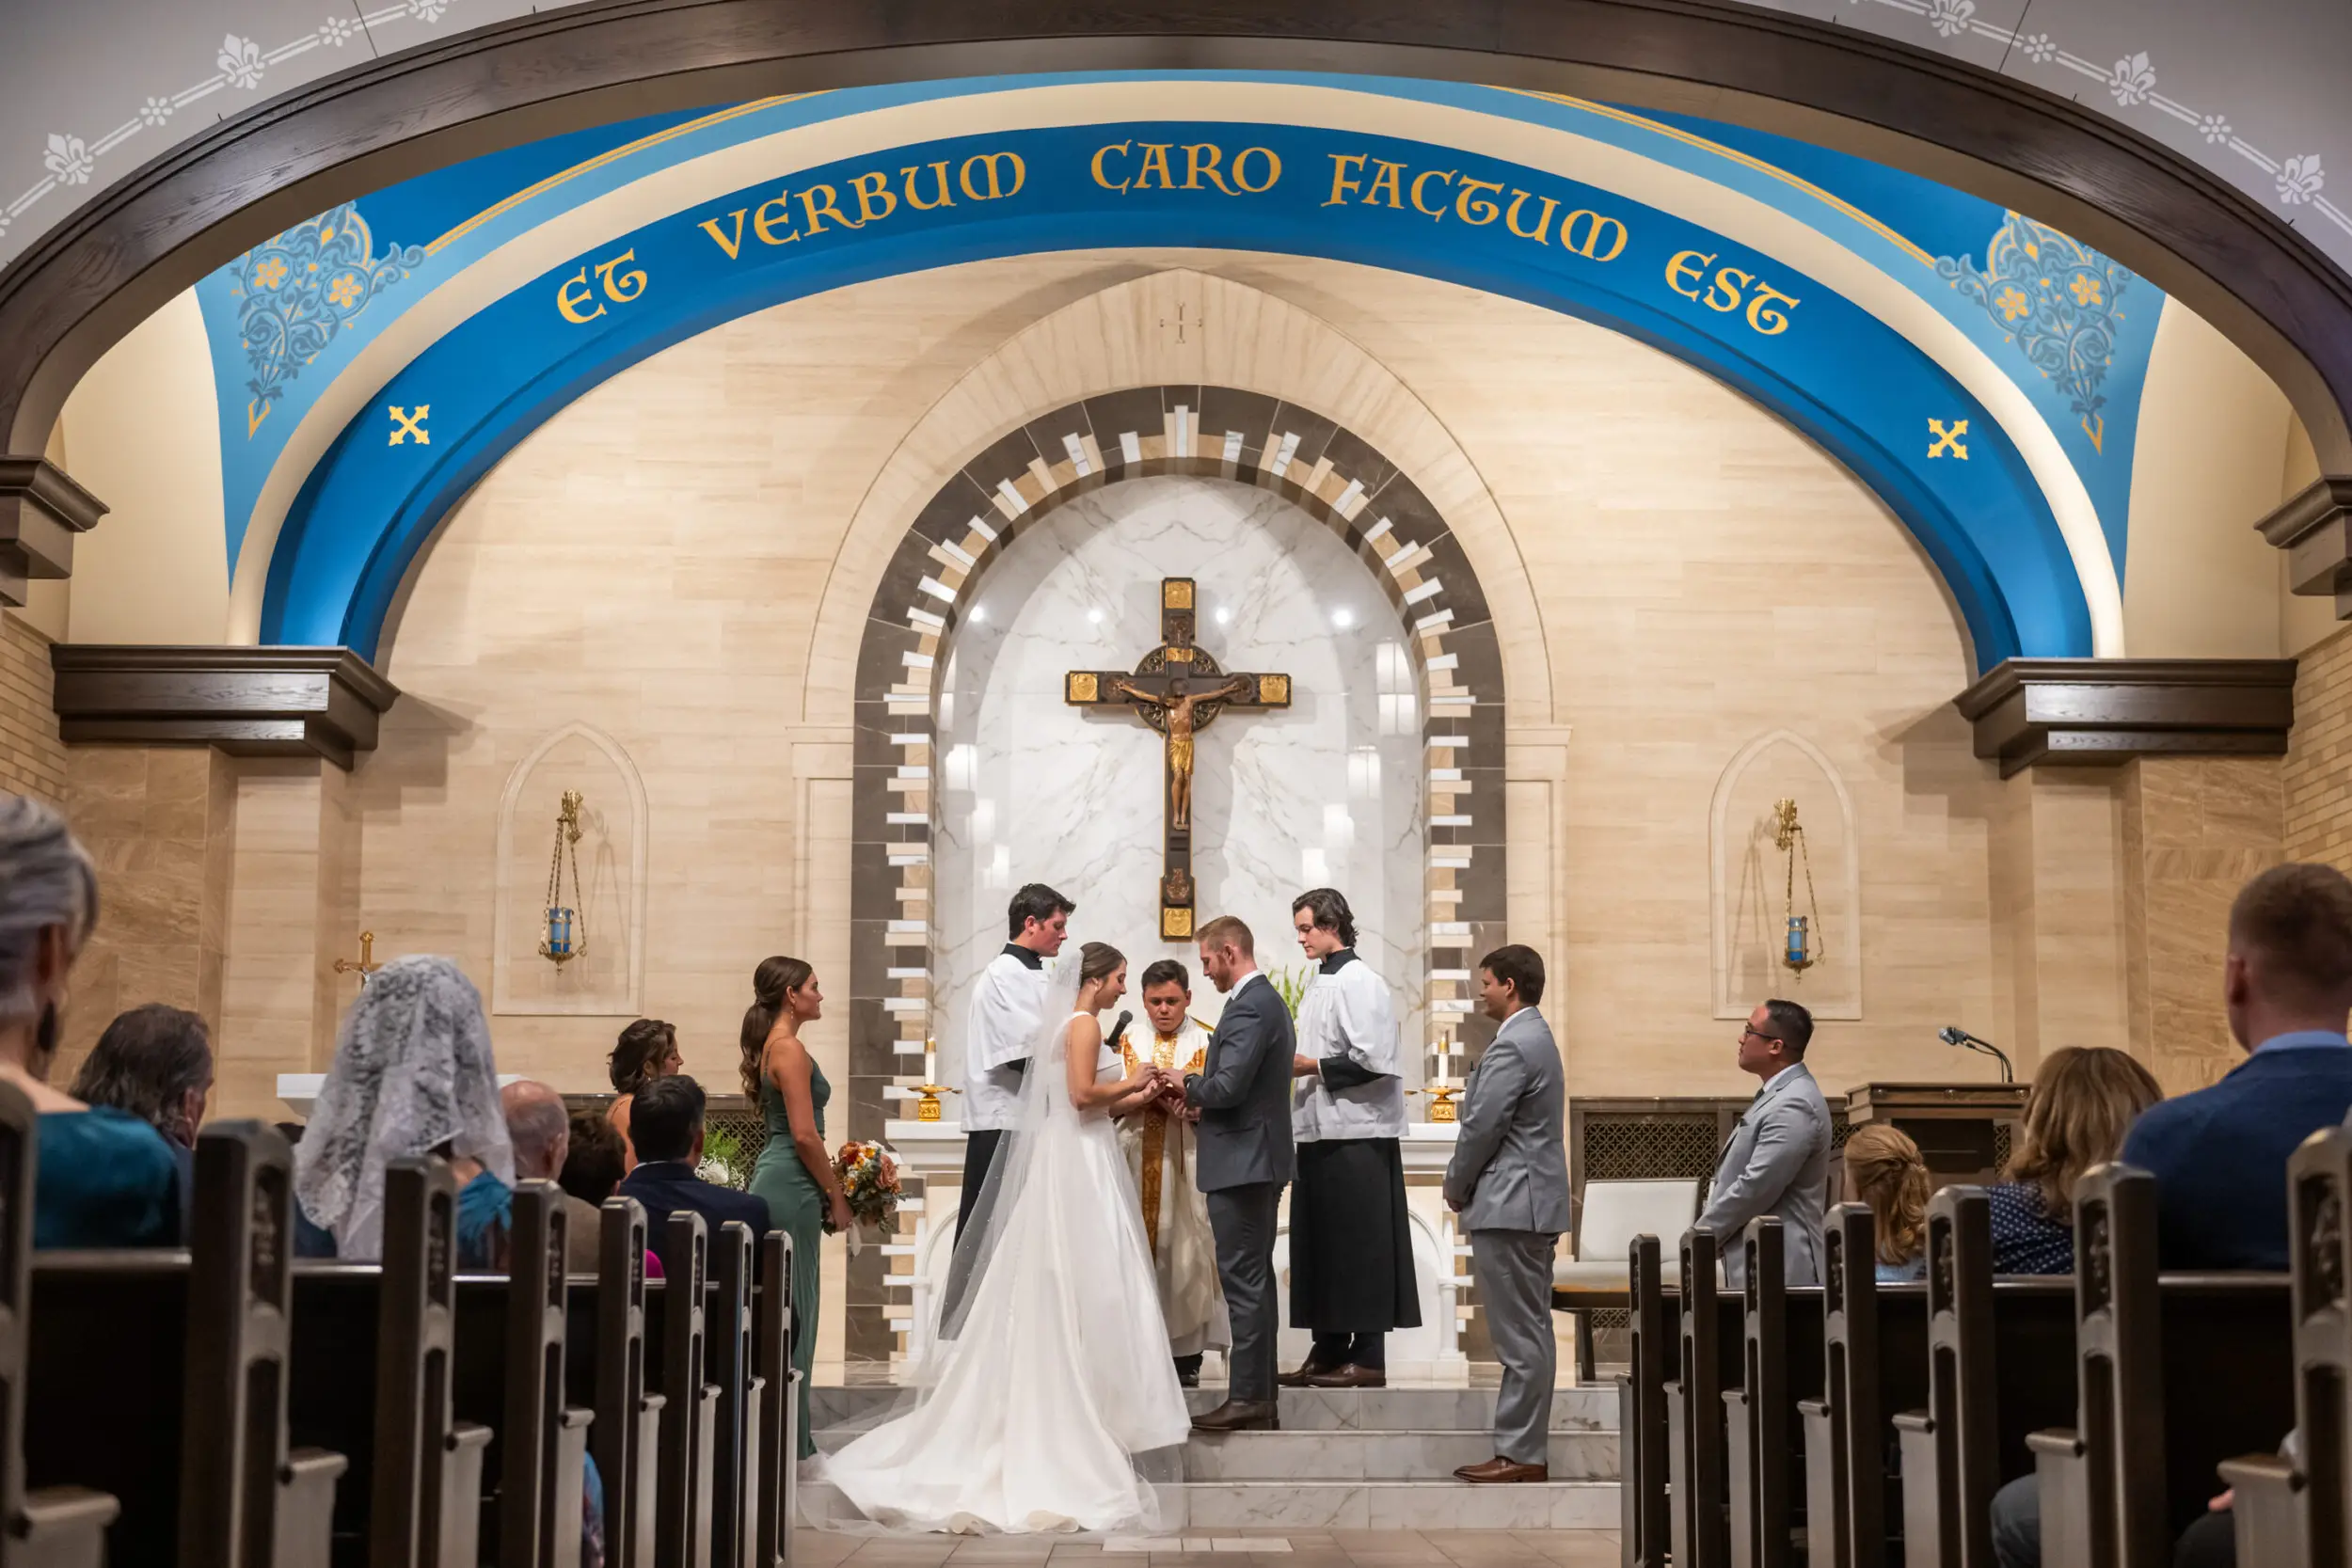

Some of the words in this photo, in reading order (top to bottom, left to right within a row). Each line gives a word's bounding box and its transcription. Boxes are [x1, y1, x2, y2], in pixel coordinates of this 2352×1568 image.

[557, 248, 648, 324] ET
[697, 151, 1026, 260] VERBUM
[1090, 138, 1282, 197] CARO
[1322, 153, 1629, 262] FACTUM
[1665, 250, 1800, 335] EST
